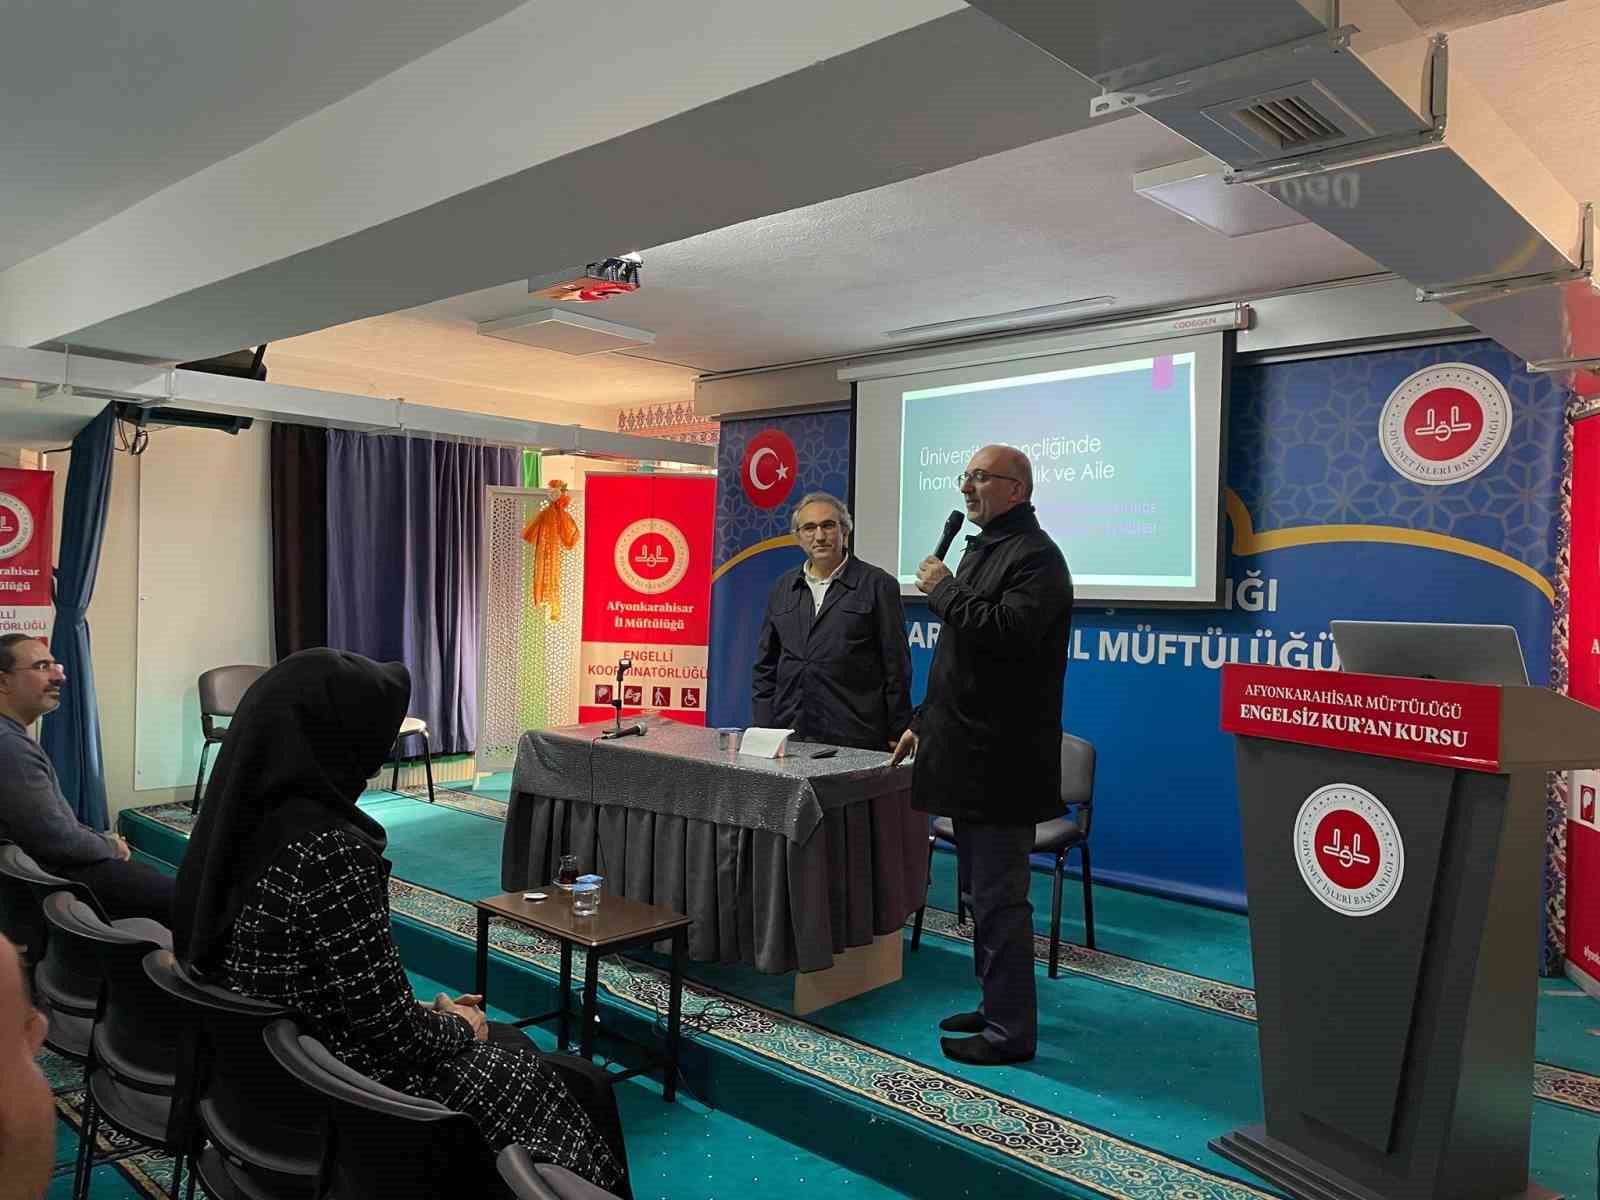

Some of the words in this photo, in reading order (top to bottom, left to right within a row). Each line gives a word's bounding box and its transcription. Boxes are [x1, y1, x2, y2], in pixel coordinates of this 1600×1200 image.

[1056, 467, 1076, 482] ve
[1080, 460, 1115, 480] Aile
[606, 600, 694, 614] Afyonkarahisar
[624, 616, 685, 632] Müftülüğü
[623, 649, 673, 662] ENGELLİ
[1244, 683, 1363, 709] AFYONKARAHİSAR
[1366, 694, 1463, 720] MÜFTÜLÜĞÜ
[1239, 703, 1320, 728] ENGELSİZ
[1394, 721, 1469, 748] KURSU
